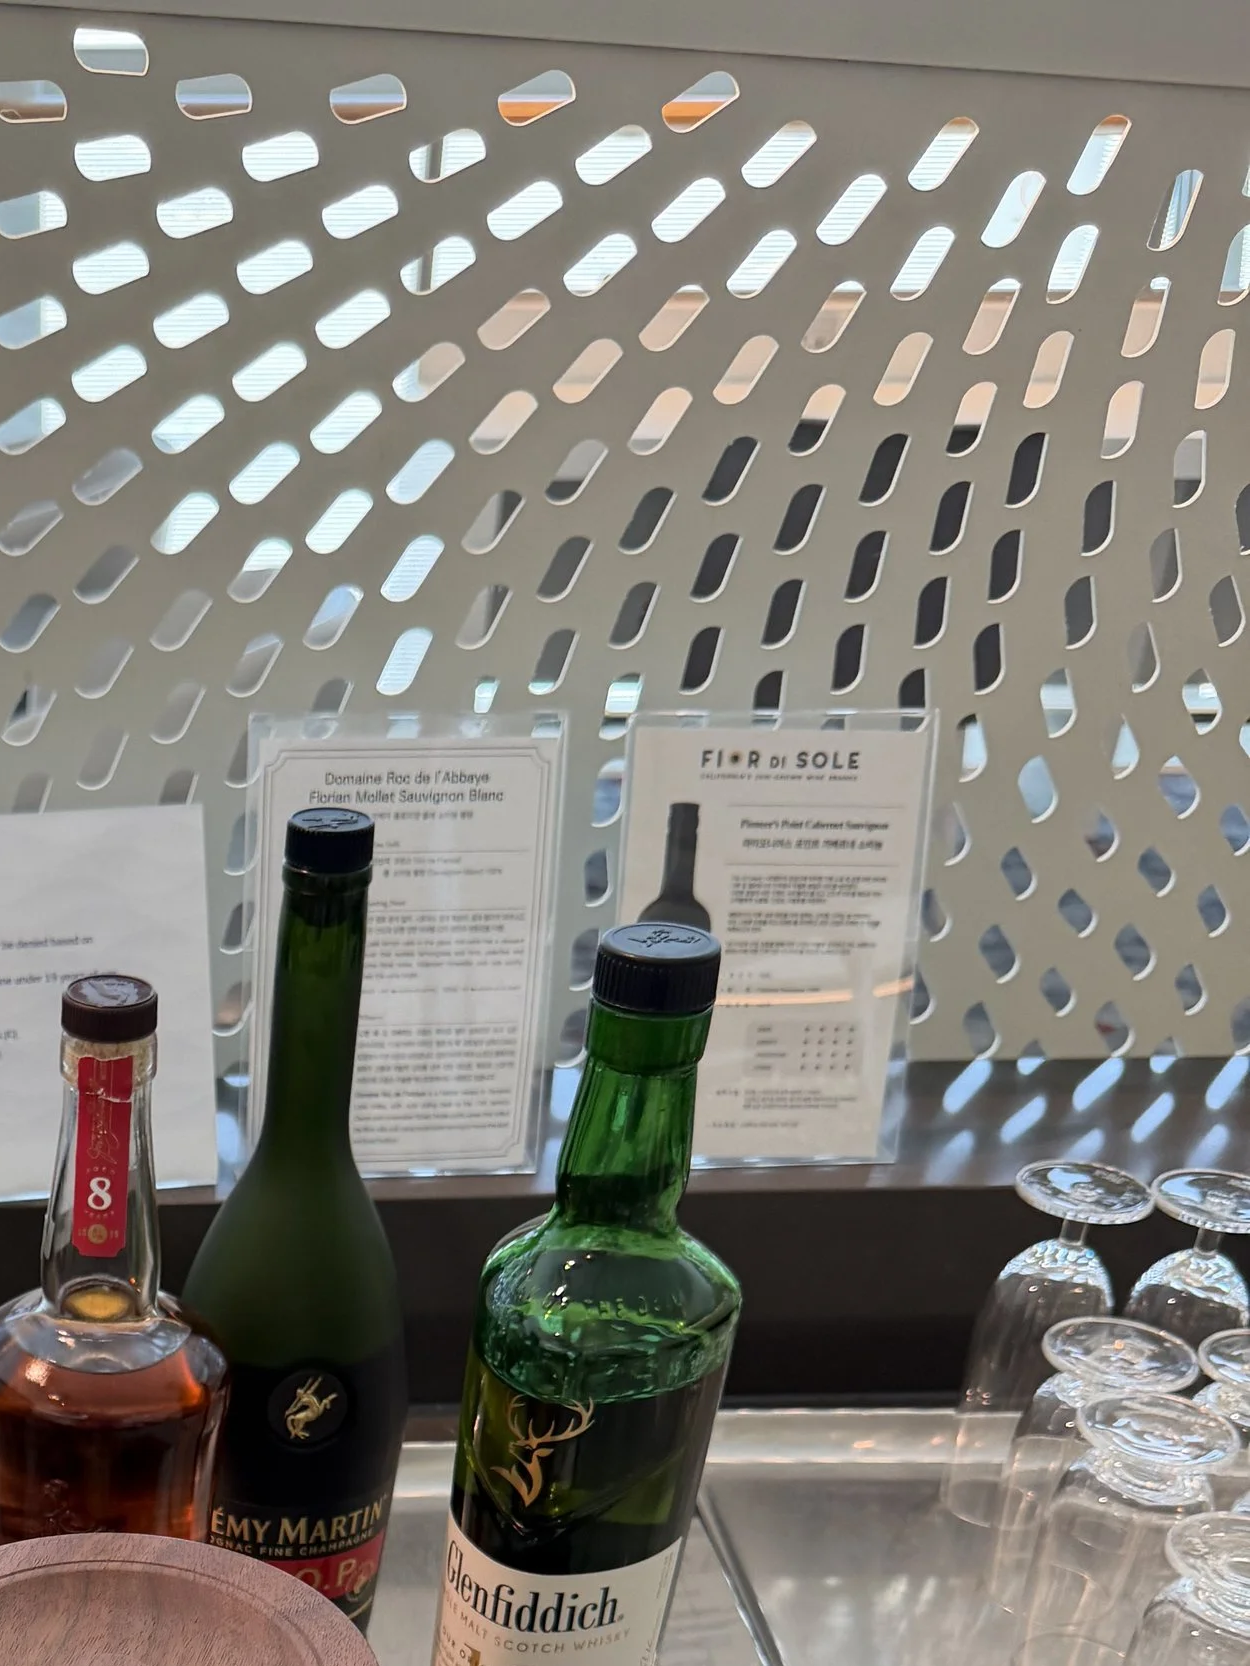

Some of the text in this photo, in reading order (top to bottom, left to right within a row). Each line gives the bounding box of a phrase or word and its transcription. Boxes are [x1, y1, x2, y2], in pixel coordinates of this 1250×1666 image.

[770, 756, 787, 769] DI
[796, 750, 860, 770] SOLE
[324, 771, 382, 786] Domaine
[386, 771, 410, 785] Roc
[414, 770, 431, 785] de
[309, 788, 504, 805] Florian Mollet Sauvignon Blanc
[87, 1176, 112, 1211] 8
[211, 1499, 384, 1546] ÉMY MARTIN
[210, 1527, 375, 1558] GNAC FINE CHAMPAGNE
[446, 1539, 620, 1634] Glenfiddich
[460, 1611, 488, 1640] MALT
[493, 1635, 565, 1655] SCOTCH
